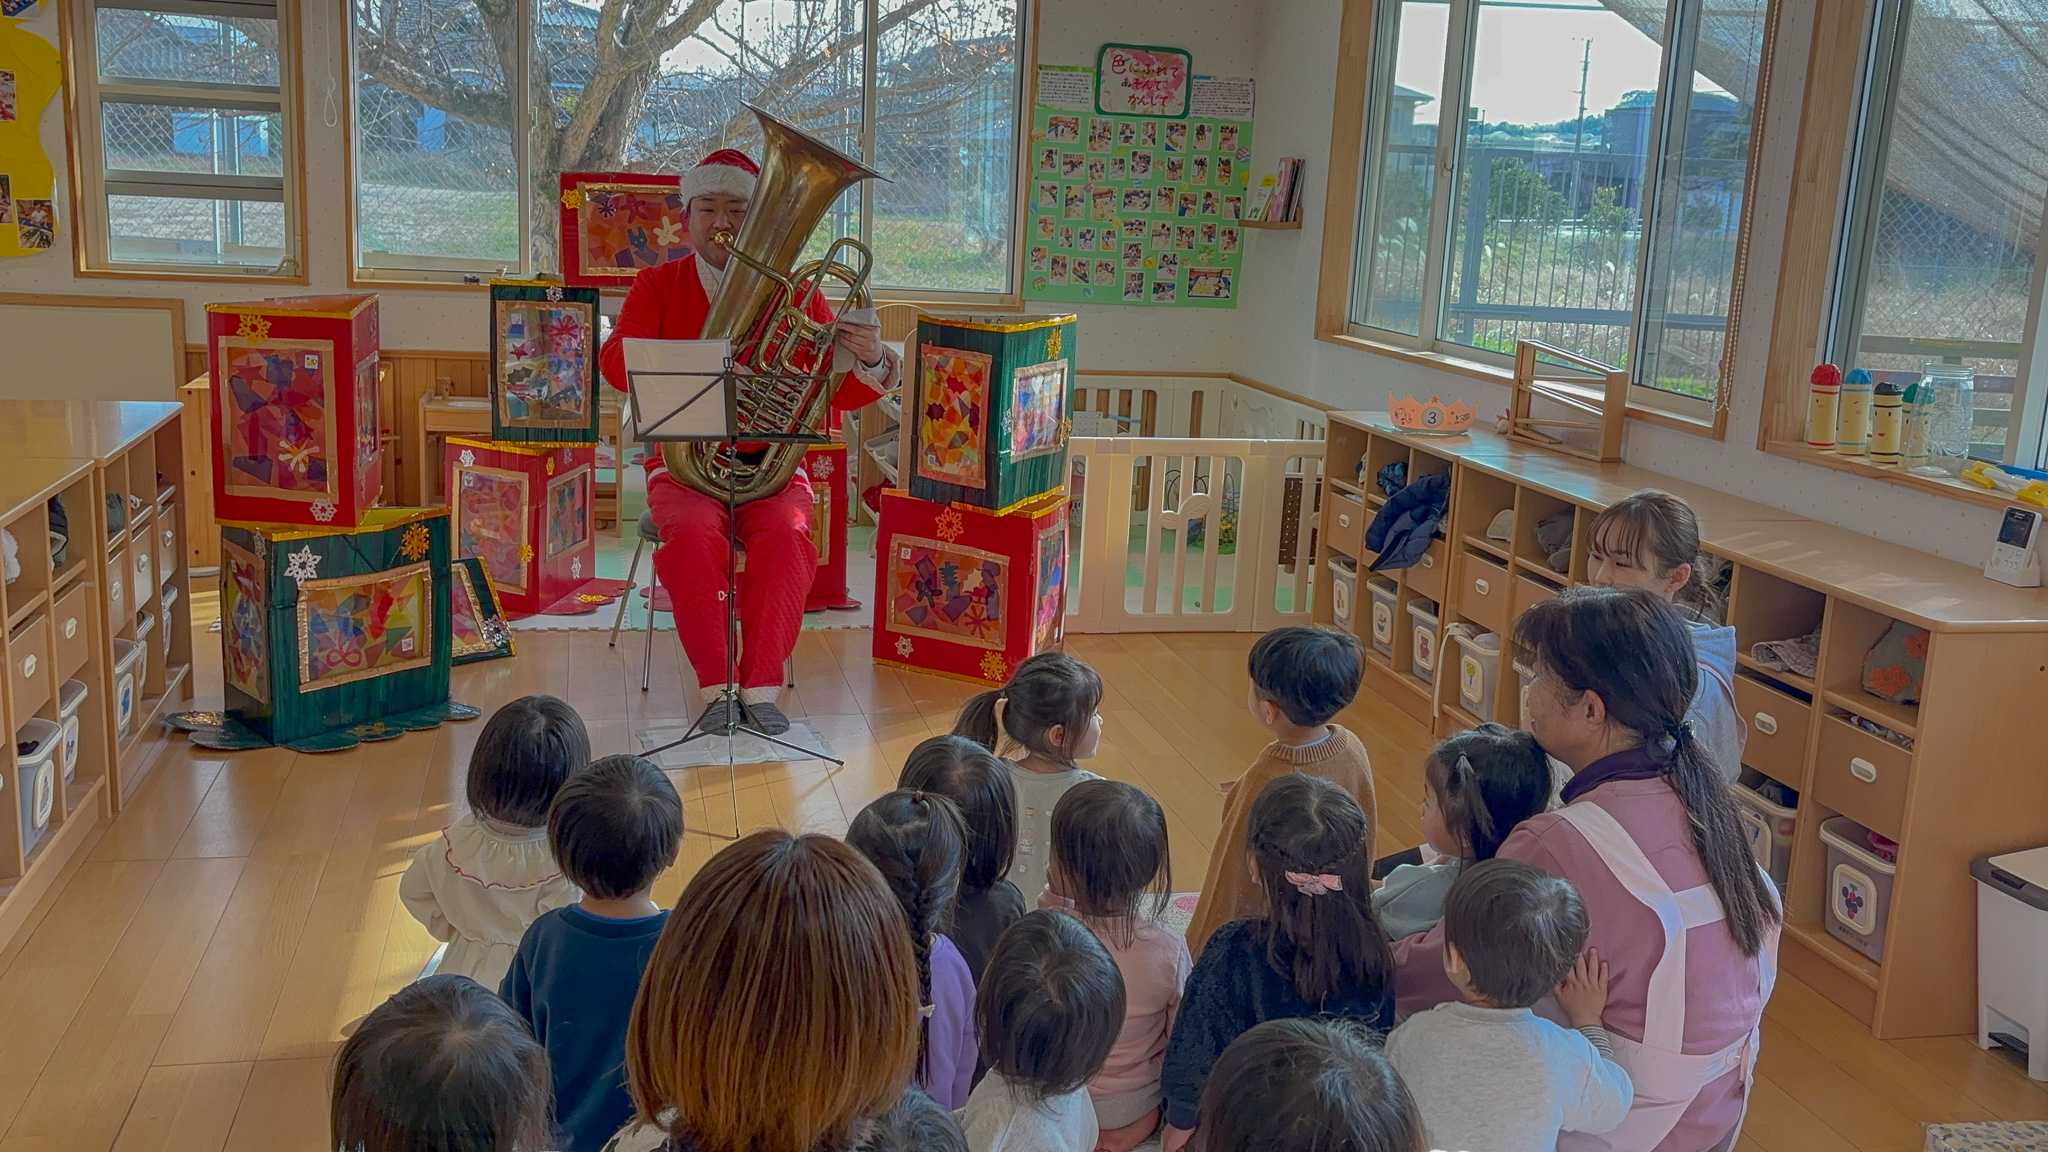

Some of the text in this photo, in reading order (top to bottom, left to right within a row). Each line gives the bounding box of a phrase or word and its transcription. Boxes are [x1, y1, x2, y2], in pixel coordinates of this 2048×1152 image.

[1112, 54, 1179, 78] 色にふれて
[1121, 76, 1168, 90] あそんで
[1427, 411, 1437, 425] 3
